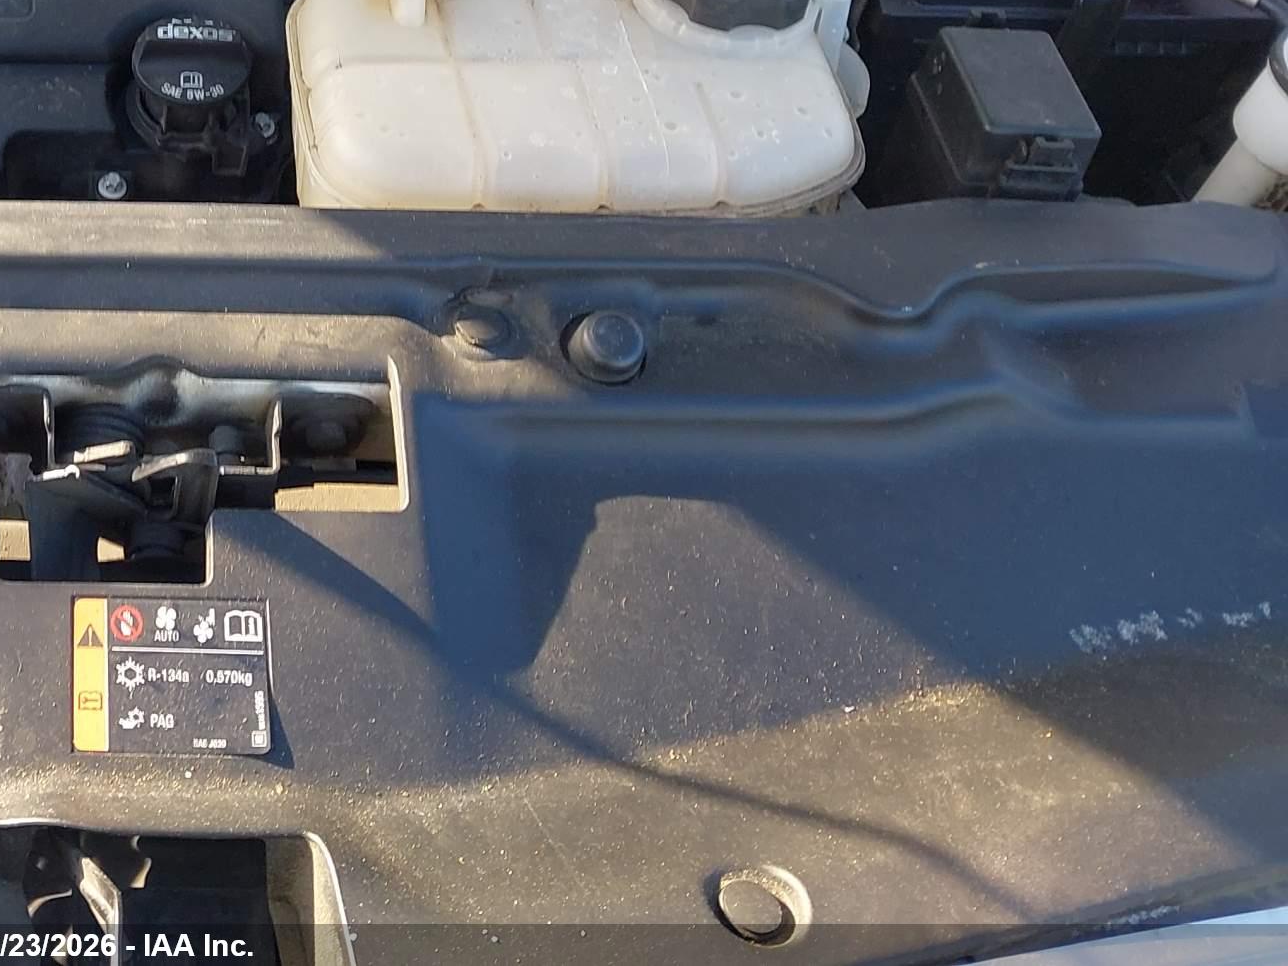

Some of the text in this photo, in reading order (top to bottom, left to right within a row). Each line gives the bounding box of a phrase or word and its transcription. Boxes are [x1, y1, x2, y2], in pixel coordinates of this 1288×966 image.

[161, 82, 183, 100] SAE
[153, 631, 180, 642] AUTO
[147, 667, 190, 683] R-134a
[149, 713, 175, 730] PAG
